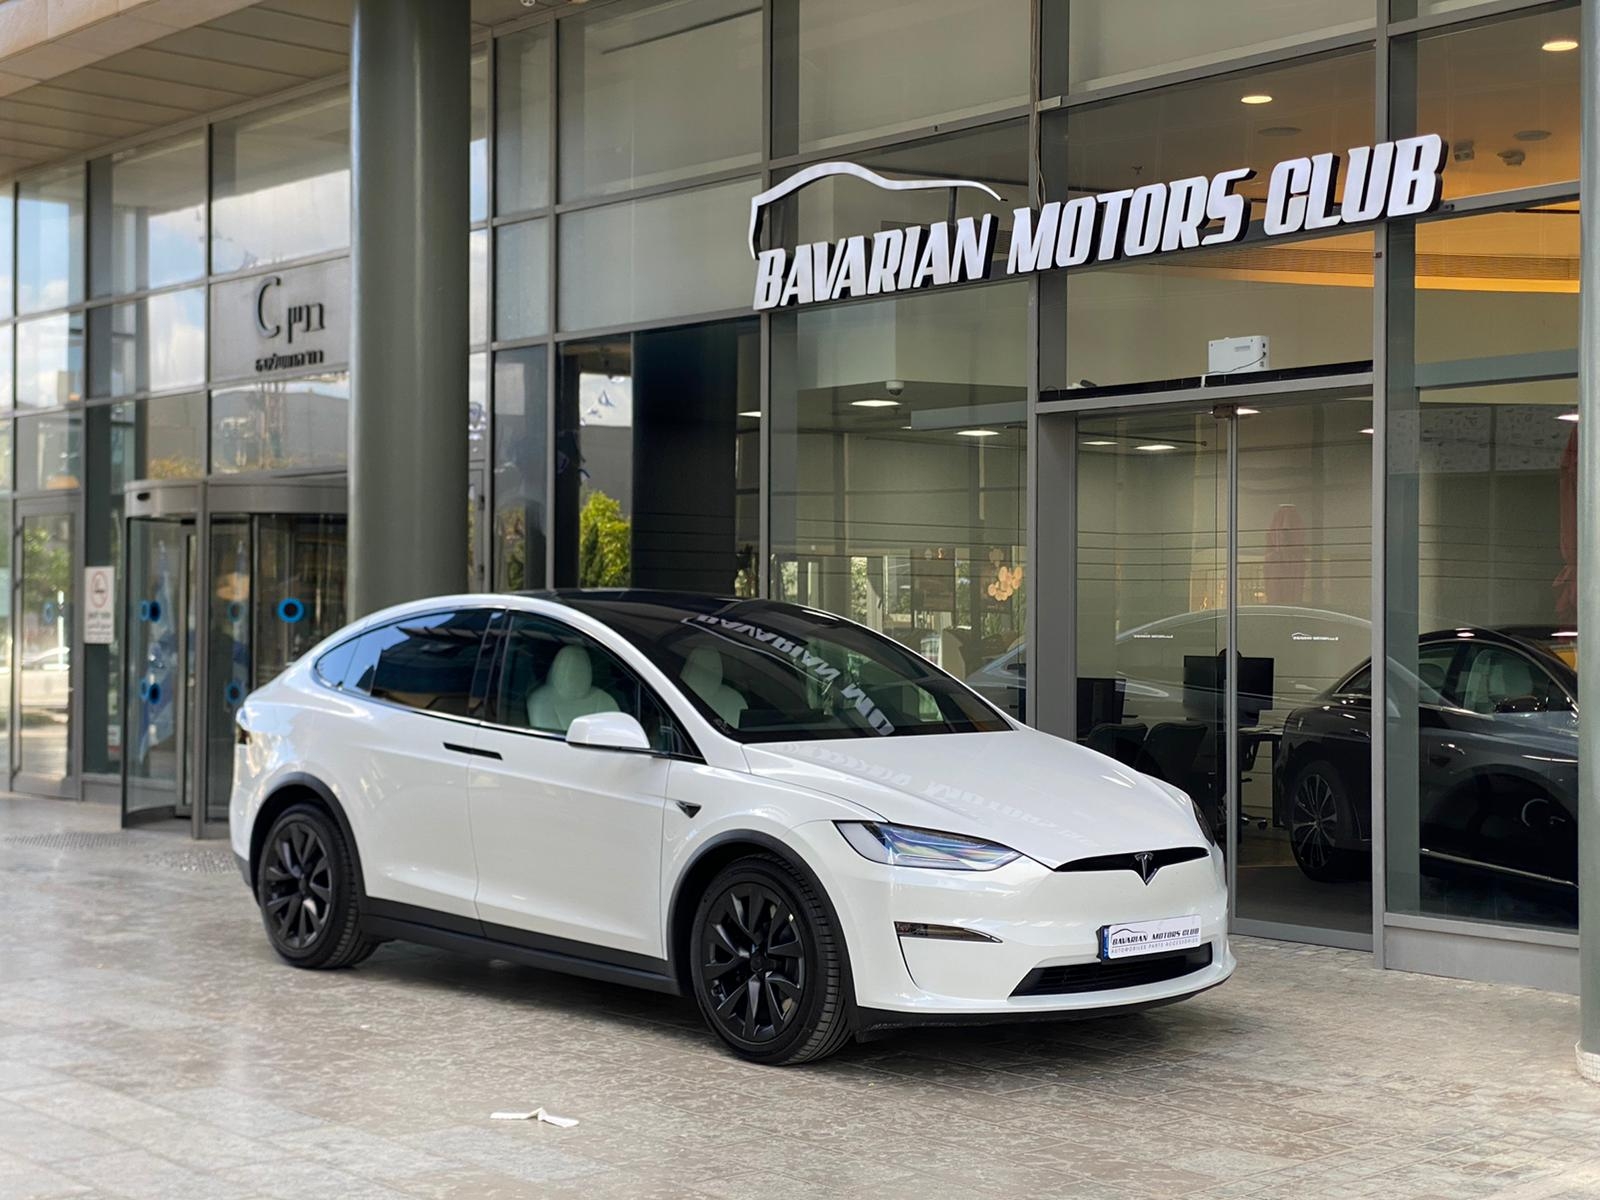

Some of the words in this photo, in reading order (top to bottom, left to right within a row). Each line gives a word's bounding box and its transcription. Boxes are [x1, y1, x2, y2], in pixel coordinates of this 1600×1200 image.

[753, 213, 998, 311] BAVARIAN
[1006, 167, 1252, 274] MOTORS
[1263, 133, 1445, 236] CLUB
[255, 275, 281, 338] C
[1112, 935, 1148, 945] BAVARIAN
[1152, 931, 1181, 940] MOTORS
[1182, 928, 1199, 937] CLUB
